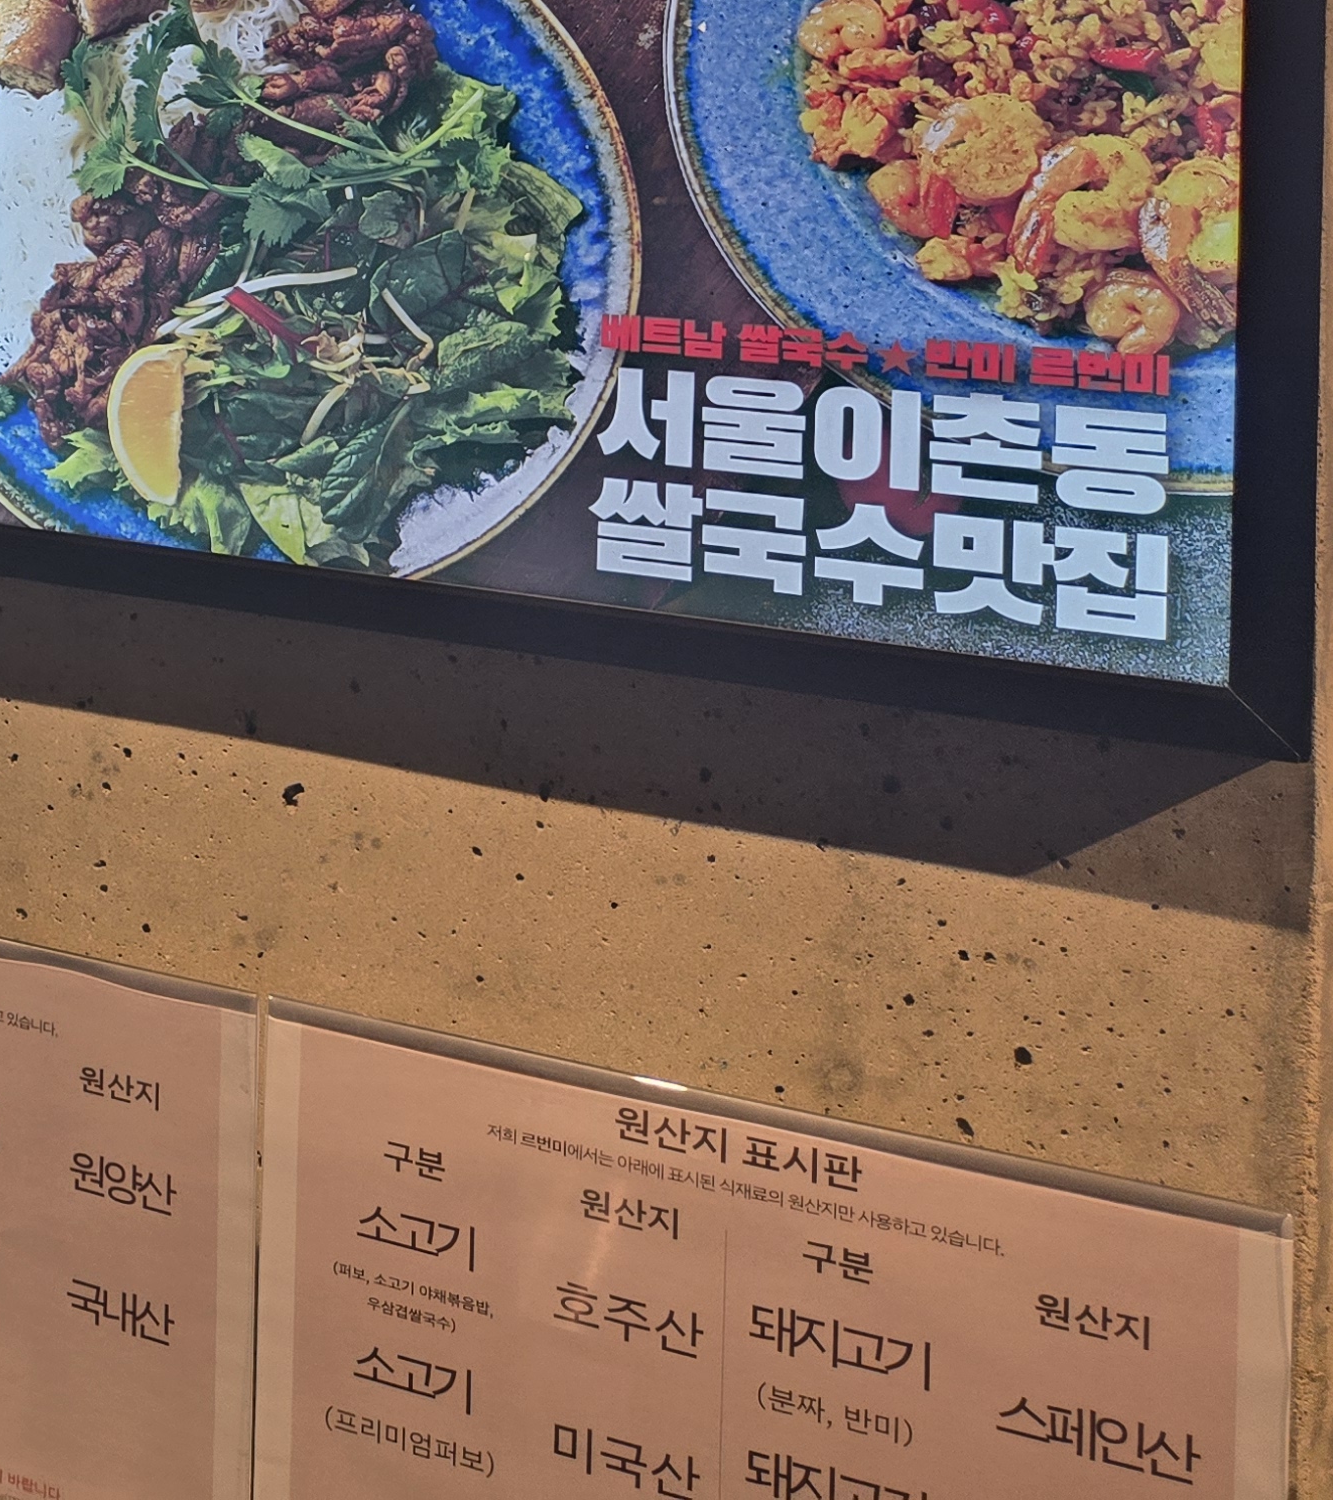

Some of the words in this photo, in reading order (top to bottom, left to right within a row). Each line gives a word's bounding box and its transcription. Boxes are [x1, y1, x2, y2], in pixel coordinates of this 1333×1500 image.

[601, 313, 727, 359] 베트남
[738, 325, 869, 371] 쌀국수
[925, 340, 1016, 384] 반미
[1030, 346, 1171, 396] 르번미
[596, 369, 1170, 515] 서울이촌동
[589, 478, 1170, 641] 쌀국수맛집
[79, 1066, 161, 1110] 원산지
[69, 1151, 177, 1215] 원양산
[383, 1140, 446, 1181] 구분
[613, 1105, 730, 1163] 원산지
[742, 1133, 864, 1193] 표시판
[487, 1121, 517, 1146] 저희
[521, 1130, 613, 1168] 르번미에서는
[616, 1152, 664, 1179] 아래에
[667, 1163, 716, 1191] 표시된
[719, 1176, 783, 1206] 식재료의
[787, 1190, 854, 1223] 원산지만
[859, 1206, 926, 1239] 사용하고
[930, 1221, 1006, 1258] 있습니다.
[579, 1186, 680, 1239] 원산지
[357, 1203, 478, 1270] 소고기
[802, 1239, 874, 1286] 구분
[66, 1279, 174, 1345] 국내산
[332, 1260, 371, 1286] (퍼보,
[374, 1271, 416, 1297] 소고기
[418, 1284, 496, 1319] 야채볶음밥,
[367, 1296, 457, 1333] 우삼겹쌀국수)
[552, 1282, 704, 1358] 호주산
[1034, 1292, 1151, 1348] 원산지
[353, 1344, 475, 1414] 소고기
[748, 1303, 933, 1388] 돼지고기
[324, 1405, 496, 1478] (프리미엄퍼보)
[756, 1381, 835, 1429] (분짜,
[842, 1404, 913, 1448] 반미)
[995, 1392, 1202, 1482] 스페인산
[552, 1423, 700, 1500] 미국산
